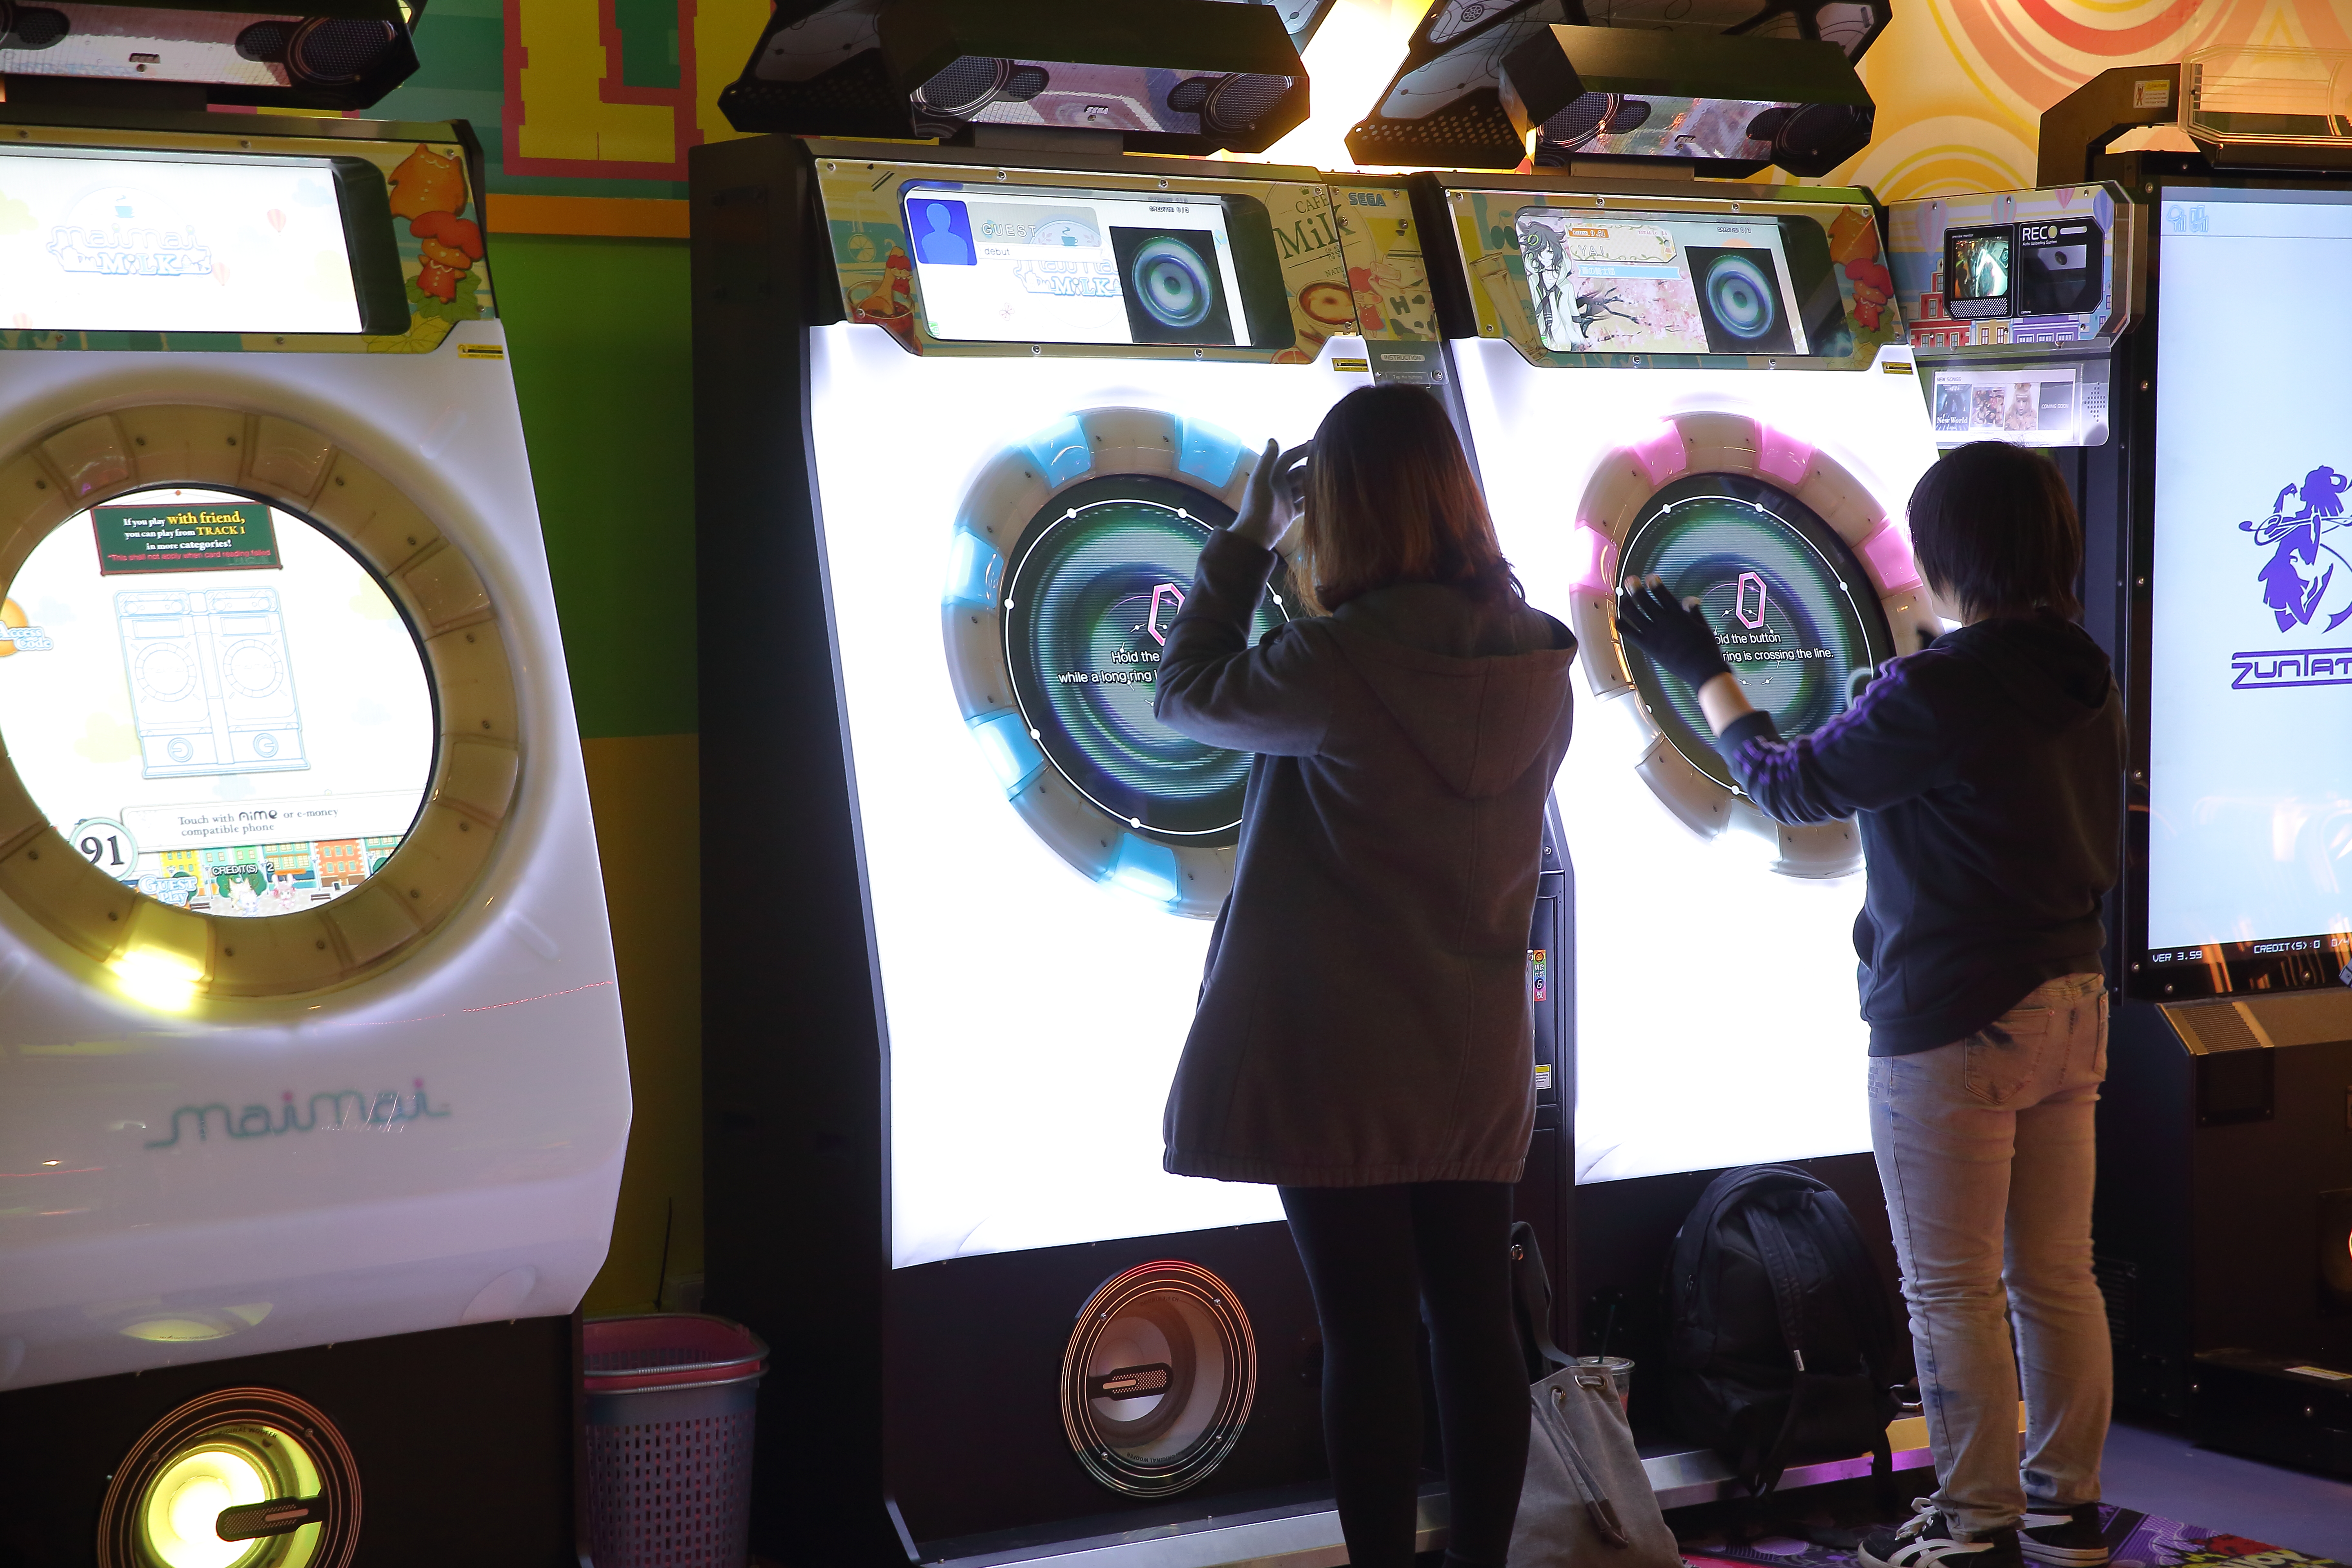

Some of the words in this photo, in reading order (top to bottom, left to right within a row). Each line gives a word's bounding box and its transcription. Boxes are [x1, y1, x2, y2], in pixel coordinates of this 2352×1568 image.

[1295, 194, 1330, 214] CAFE
[1348, 192, 1387, 207] SEGA
[982, 223, 1037, 238] GUEST
[984, 247, 1010, 256] debut
[123, 518, 132, 527] If
[148, 517, 165, 527] play
[167, 512, 198, 525] with
[200, 510, 245, 525] friend,
[125, 532, 141, 541] you
[157, 529, 174, 539] play
[174, 528, 196, 537] from
[196, 526, 238, 536] TRACK
[240, 526, 246, 535] 1
[179, 539, 232, 551] categories!
[16, 637, 51, 648] Code
[1715, 633, 1730, 644] old
[1731, 634, 1748, 644] the
[1749, 633, 1782, 643] button
[1111, 651, 1139, 664] Hold
[1140, 651, 1160, 662] the
[1723, 651, 1742, 662] ring
[1743, 650, 1752, 660] is
[1754, 649, 1795, 660] crossing
[1796, 648, 1813, 658] the
[1814, 648, 1834, 658] line.
[1058, 671, 1088, 684] while
[1091, 673, 1099, 682] a
[1100, 670, 1127, 683] long
[1129, 670, 1152, 682] ring
[178, 815, 209, 825] Touch
[213, 813, 234, 823] with
[297, 808, 339, 818] e-money
[181, 824, 240, 837] compatible
[242, 823, 275, 835] phone
[81, 835, 125, 866] 91
[212, 864, 258, 875] CREDIT(S)
[266, 862, 274, 872] 2
[2152, 953, 2172, 962] VER
[2177, 950, 2203, 961] 3.59
[1537, 980, 1542, 989] 6
[145, 1078, 451, 1148] maimai
[1126, 1452, 1148, 1463] WOOFER
[1149, 1454, 1175, 1463] ORIGINAL
